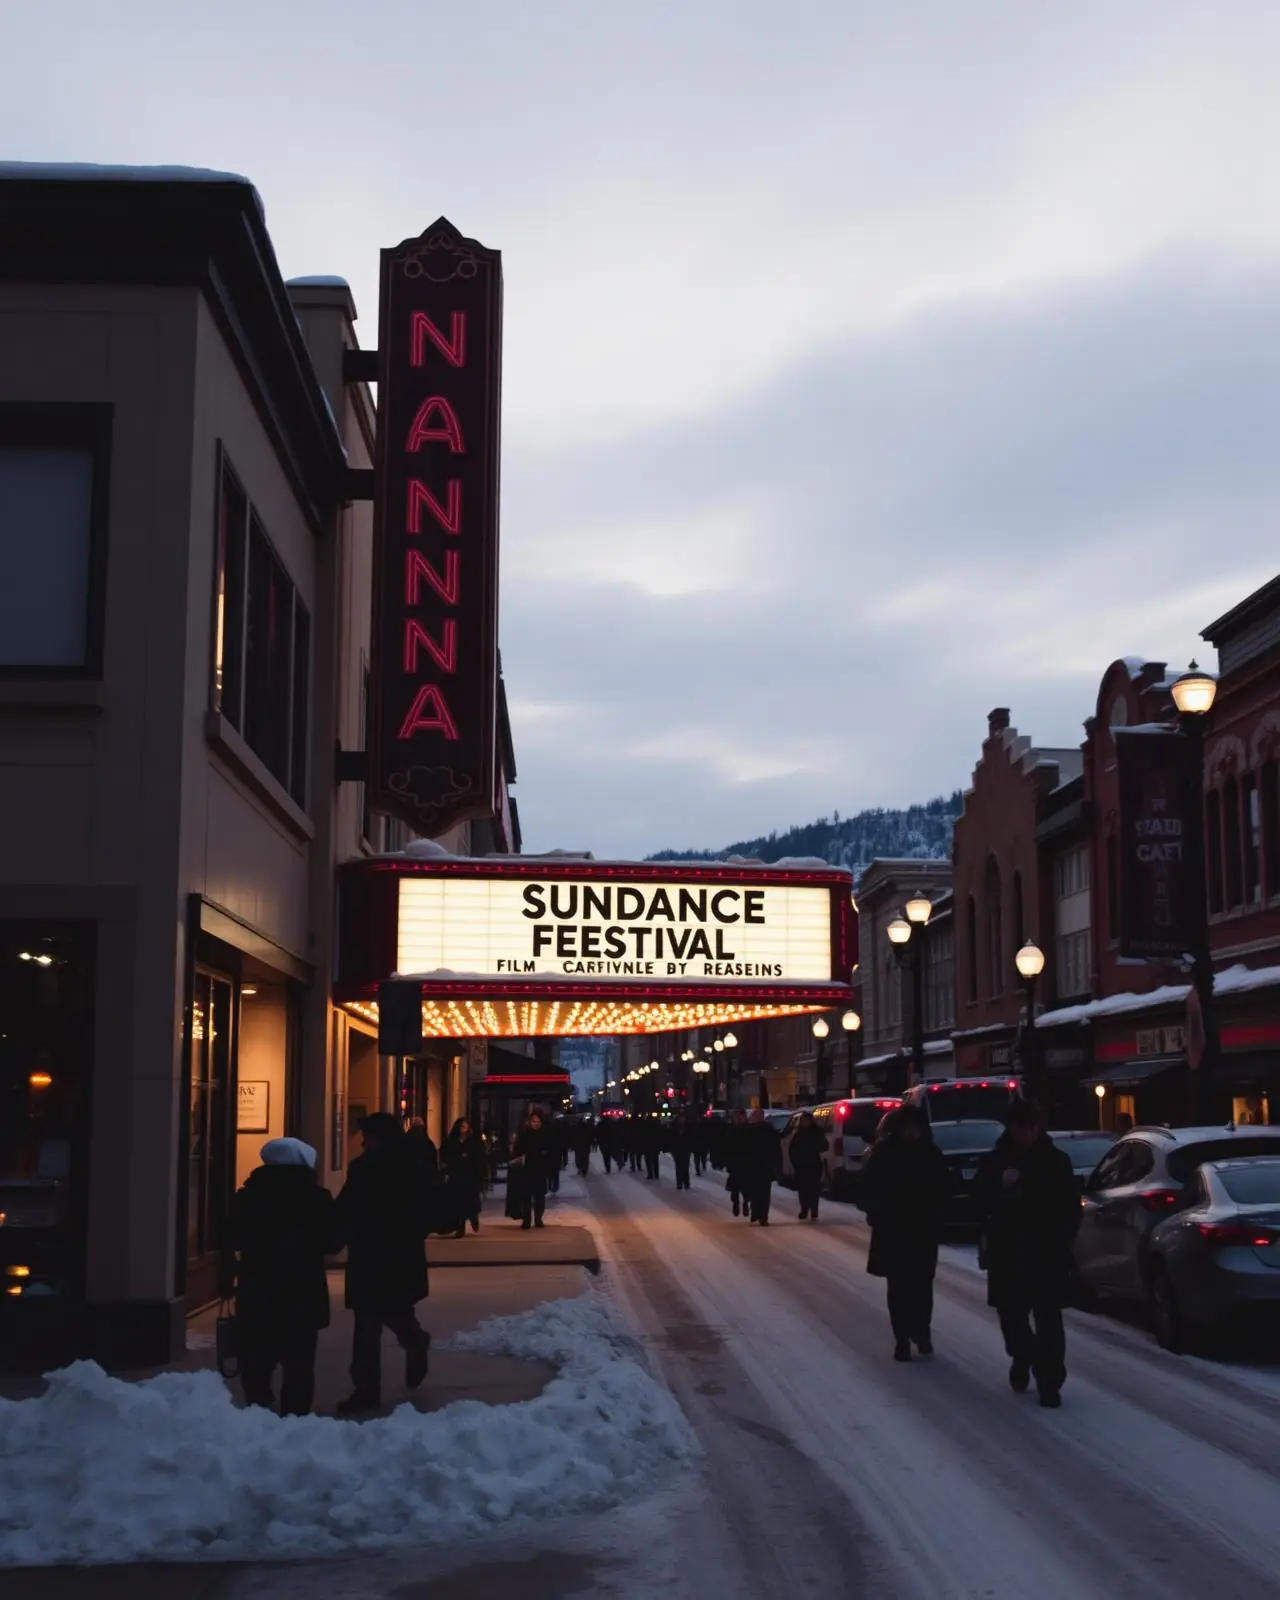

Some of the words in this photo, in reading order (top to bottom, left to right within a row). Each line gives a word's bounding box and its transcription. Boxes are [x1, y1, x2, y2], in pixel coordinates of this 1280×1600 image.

[397, 310, 467, 741] NANNNA
[522, 884, 766, 924] SUNDANCE
[532, 924, 735, 961] FEESTIVAL
[497, 959, 536, 973] FILM
[666, 962, 688, 975] BY
[703, 962, 783, 977] REASEINS
